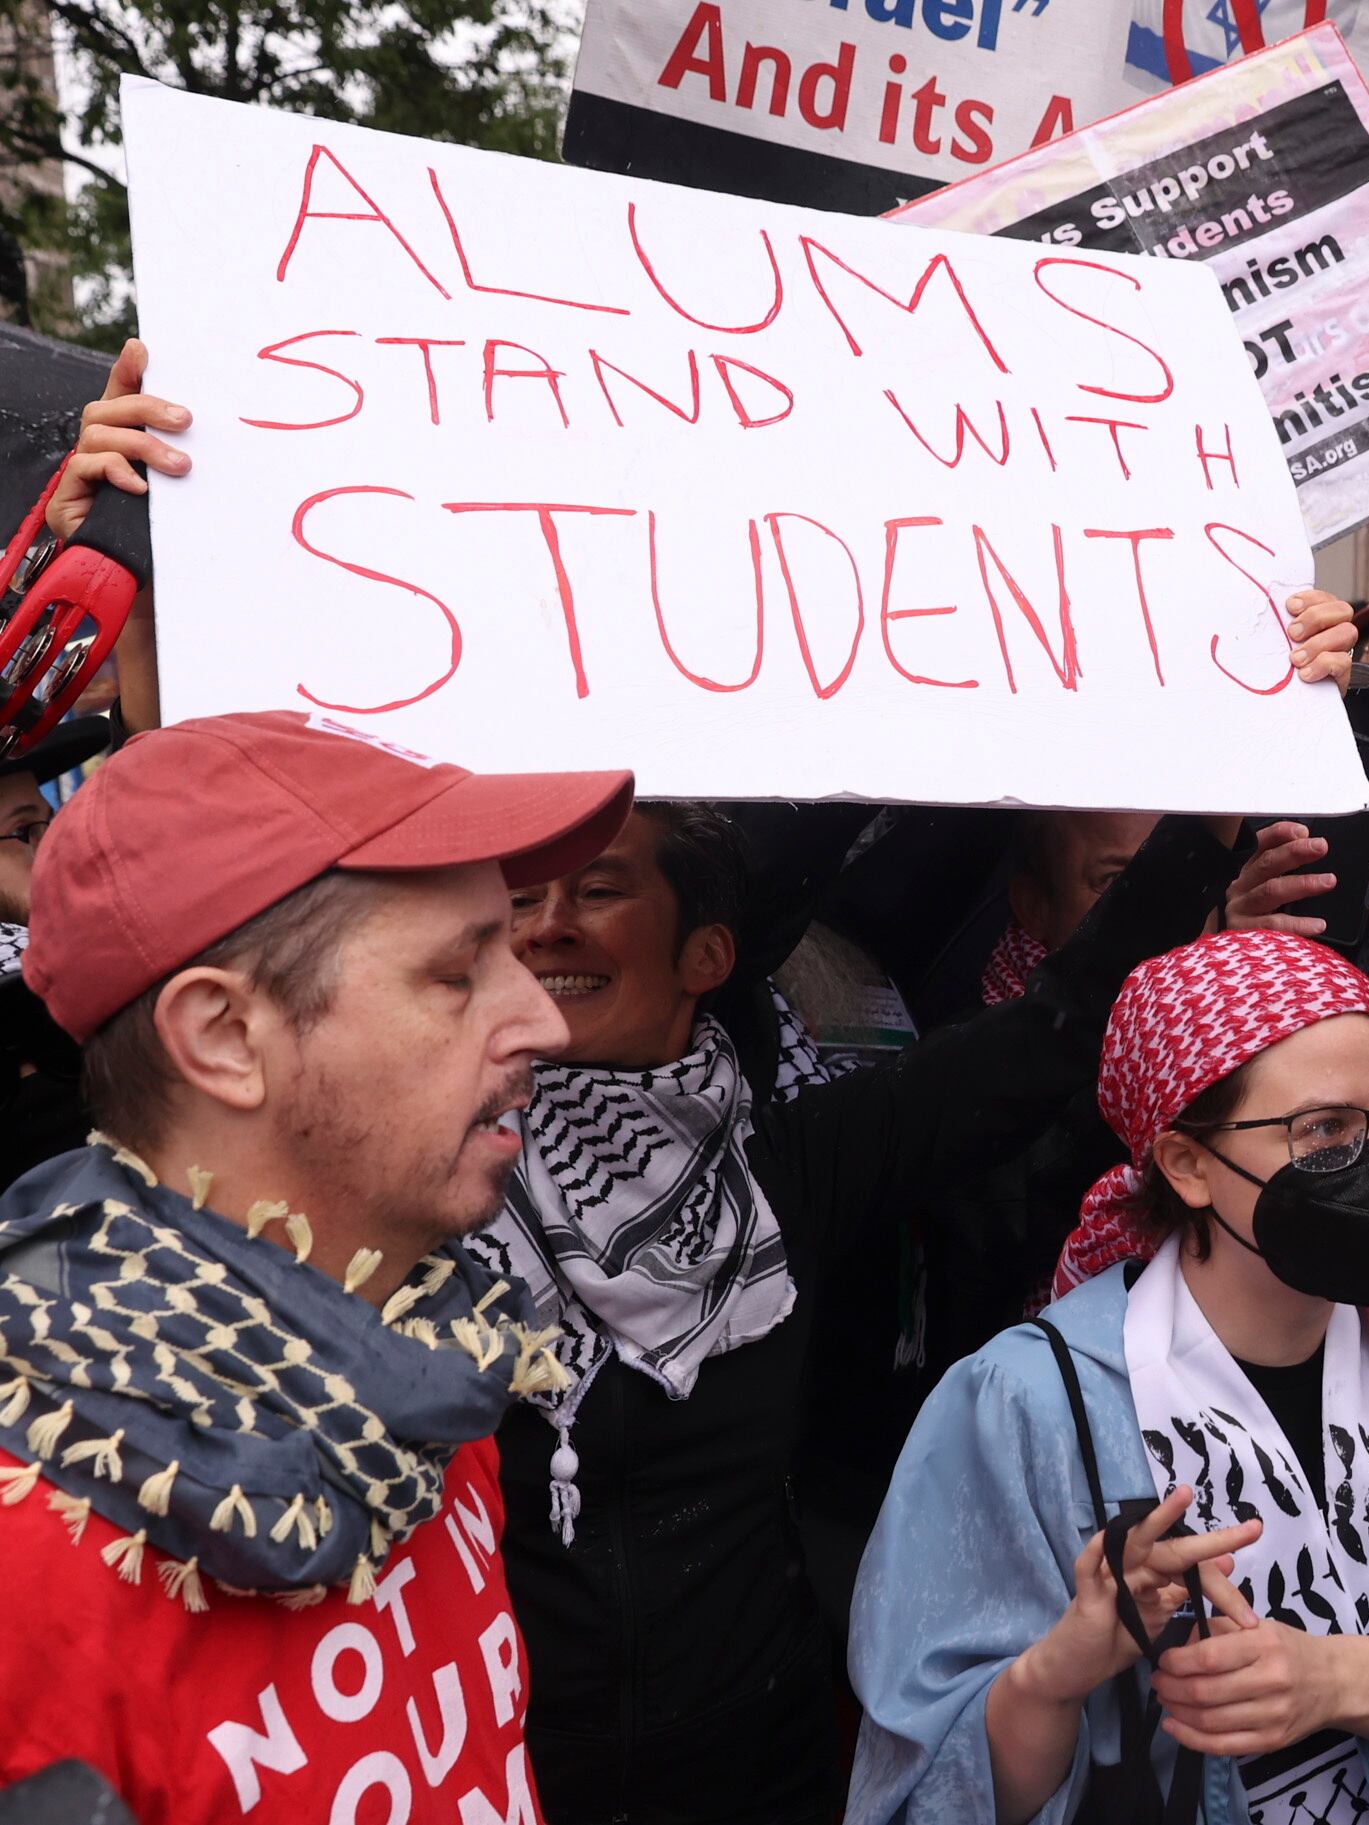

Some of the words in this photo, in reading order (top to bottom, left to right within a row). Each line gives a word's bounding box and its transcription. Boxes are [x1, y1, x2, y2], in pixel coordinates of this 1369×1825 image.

[658, 4, 856, 133] And
[878, 53, 994, 164] its
[1090, 130, 1275, 230] Support
[277, 144, 1174, 403] ALUMS
[1221, 234, 1345, 313] nism
[240, 330, 794, 430] STAND
[883, 388, 1237, 490] WITH
[1290, 438, 1358, 480] SA.org
[292, 485, 1296, 714] STUDENTS
[207, 1556, 417, 1815] NOT
[444, 1481, 496, 1594] IN
[329, 1611, 527, 1825] OUR
